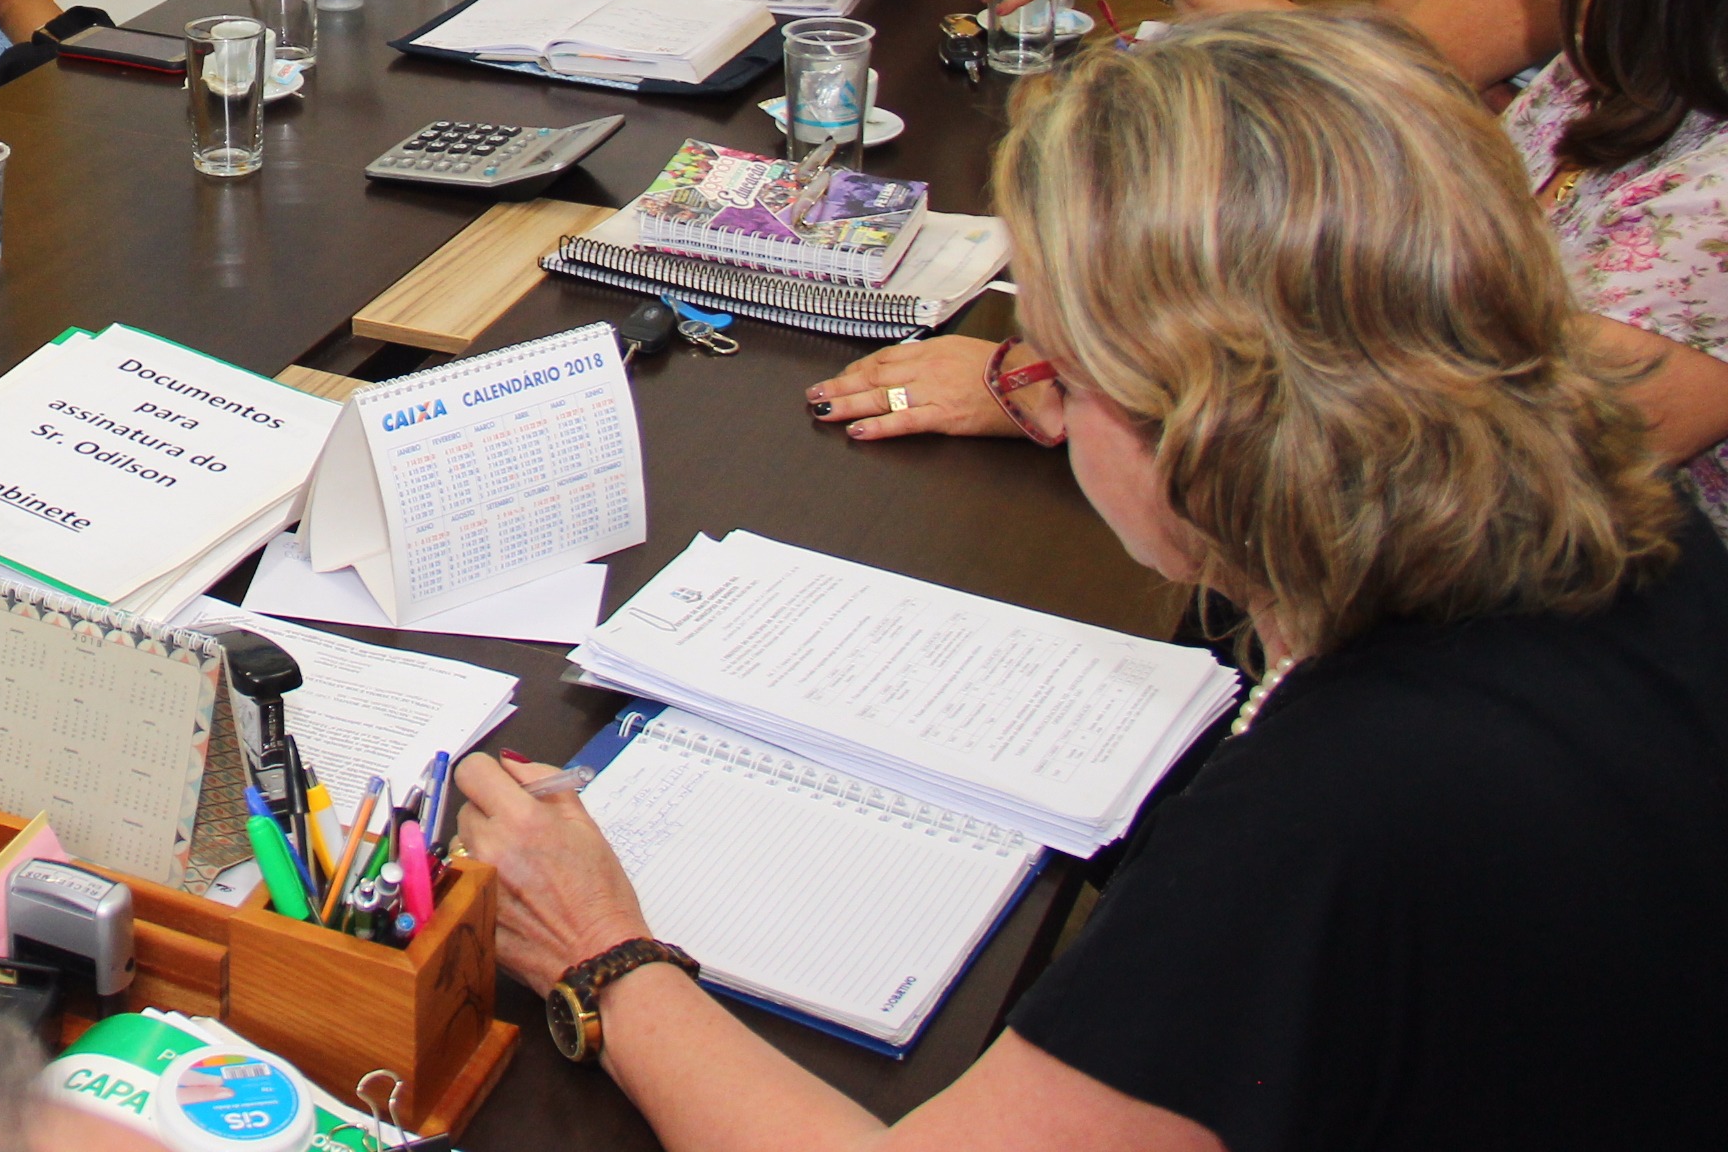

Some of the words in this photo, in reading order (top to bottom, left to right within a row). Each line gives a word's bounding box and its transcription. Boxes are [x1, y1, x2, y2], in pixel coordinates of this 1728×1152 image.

[718, 164, 767, 206] Educação
[118, 359, 285, 430] Documentos
[133, 401, 200, 430] para
[382, 399, 448, 432] CAIXA
[462, 370, 561, 407] CALENDÁRIO
[564, 353, 604, 377] 2018
[397, 444, 421, 457] JANEIRO
[432, 432, 462, 446] FEVEREIRO
[473, 421, 495, 433] MARÇO
[514, 411, 530, 420] ABRIL
[550, 399, 566, 409] MAIO
[584, 388, 604, 398] JUNHO
[31, 424, 63, 444] Sr.
[73, 441, 178, 487] Odilson
[48, 399, 185, 457] assinatura
[189, 453, 228, 473] do
[416, 522, 434, 534] JULHO
[451, 509, 475, 523] AGOSTO
[486, 497, 515, 510] SETEMBRO
[523, 485, 550, 498] OUTUBRO
[556, 472, 588, 487] NOVEMBRO
[593, 461, 622, 475] DEZEMBRO
[72, 634, 103, 648] 2018
[64, 1068, 151, 1115] CAPA
